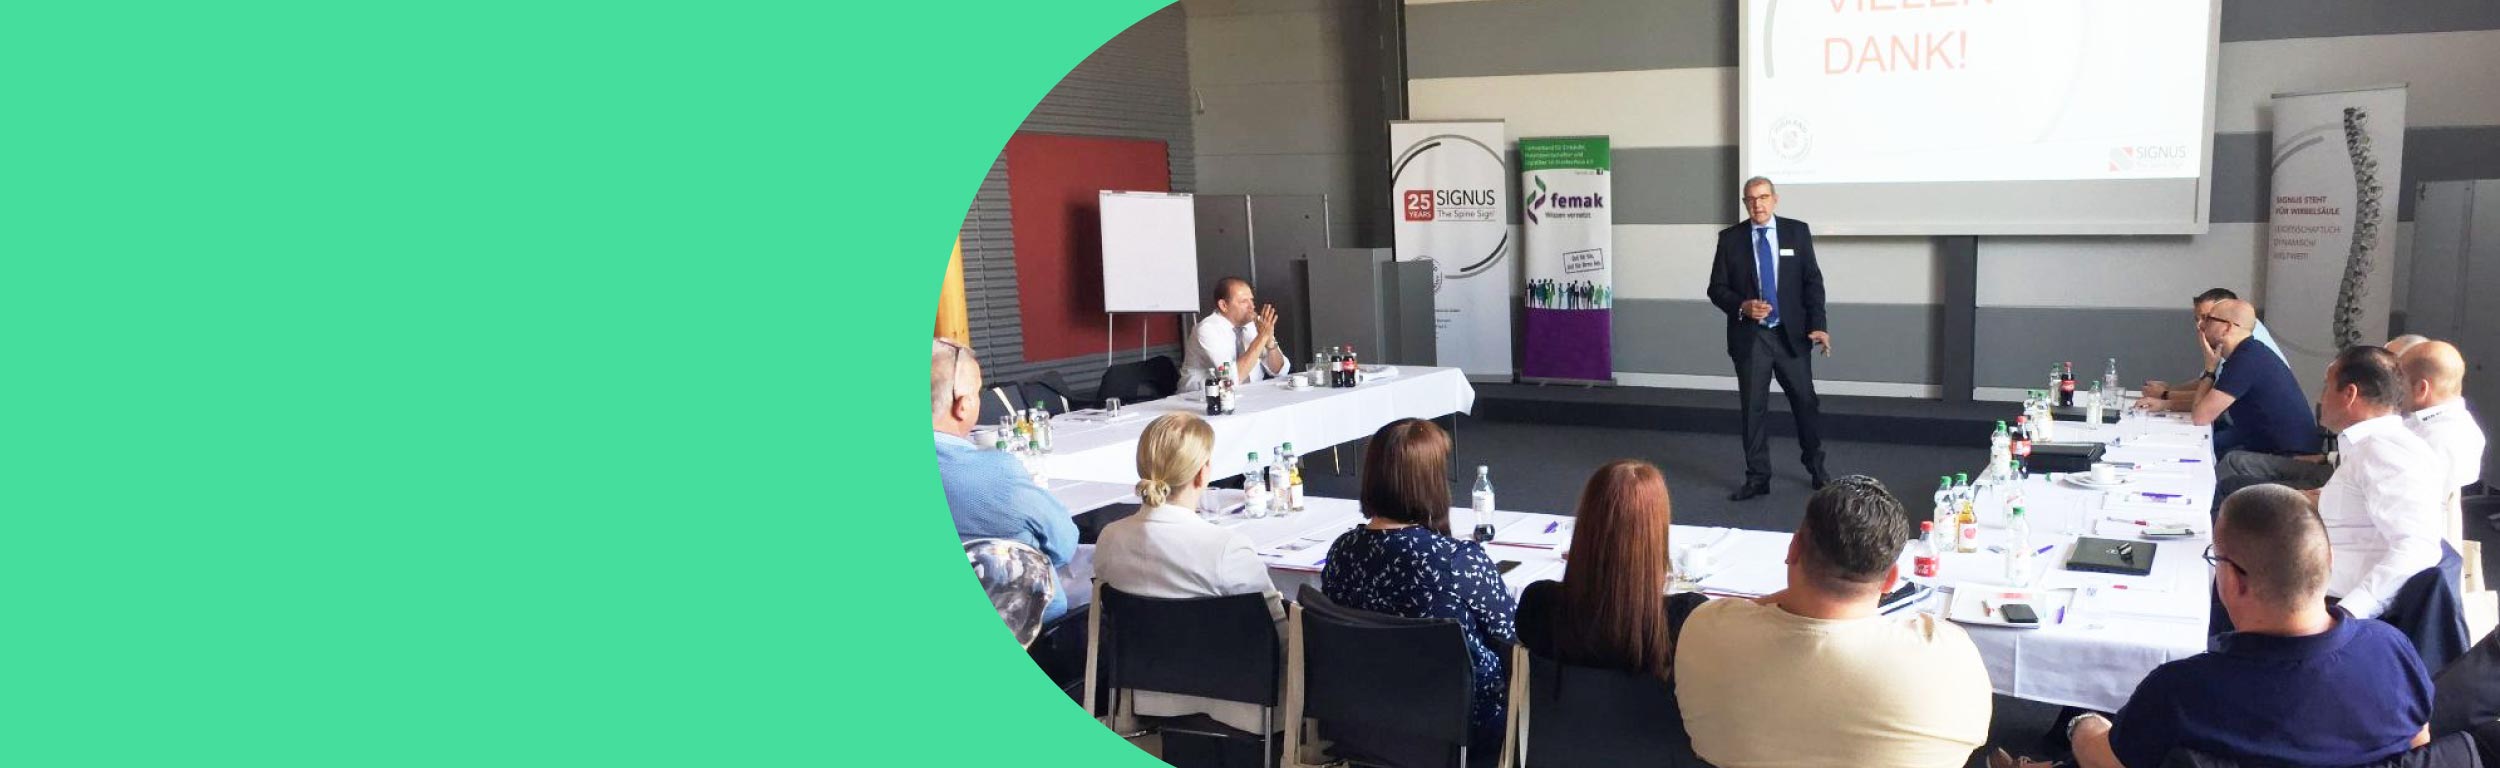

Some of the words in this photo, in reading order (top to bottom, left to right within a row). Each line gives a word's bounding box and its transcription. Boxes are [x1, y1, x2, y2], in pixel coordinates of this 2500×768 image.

[1823, 29, 1967, 75] DANK!
[2136, 145, 2186, 159] SIGNUS
[1407, 193, 1432, 210] 25
[1436, 189, 1495, 206] SIGNUS
[1550, 192, 1603, 209] femak
[1408, 210, 1432, 218] YEARS
[1438, 210, 1452, 218] The
[1454, 210, 1476, 219] Spine
